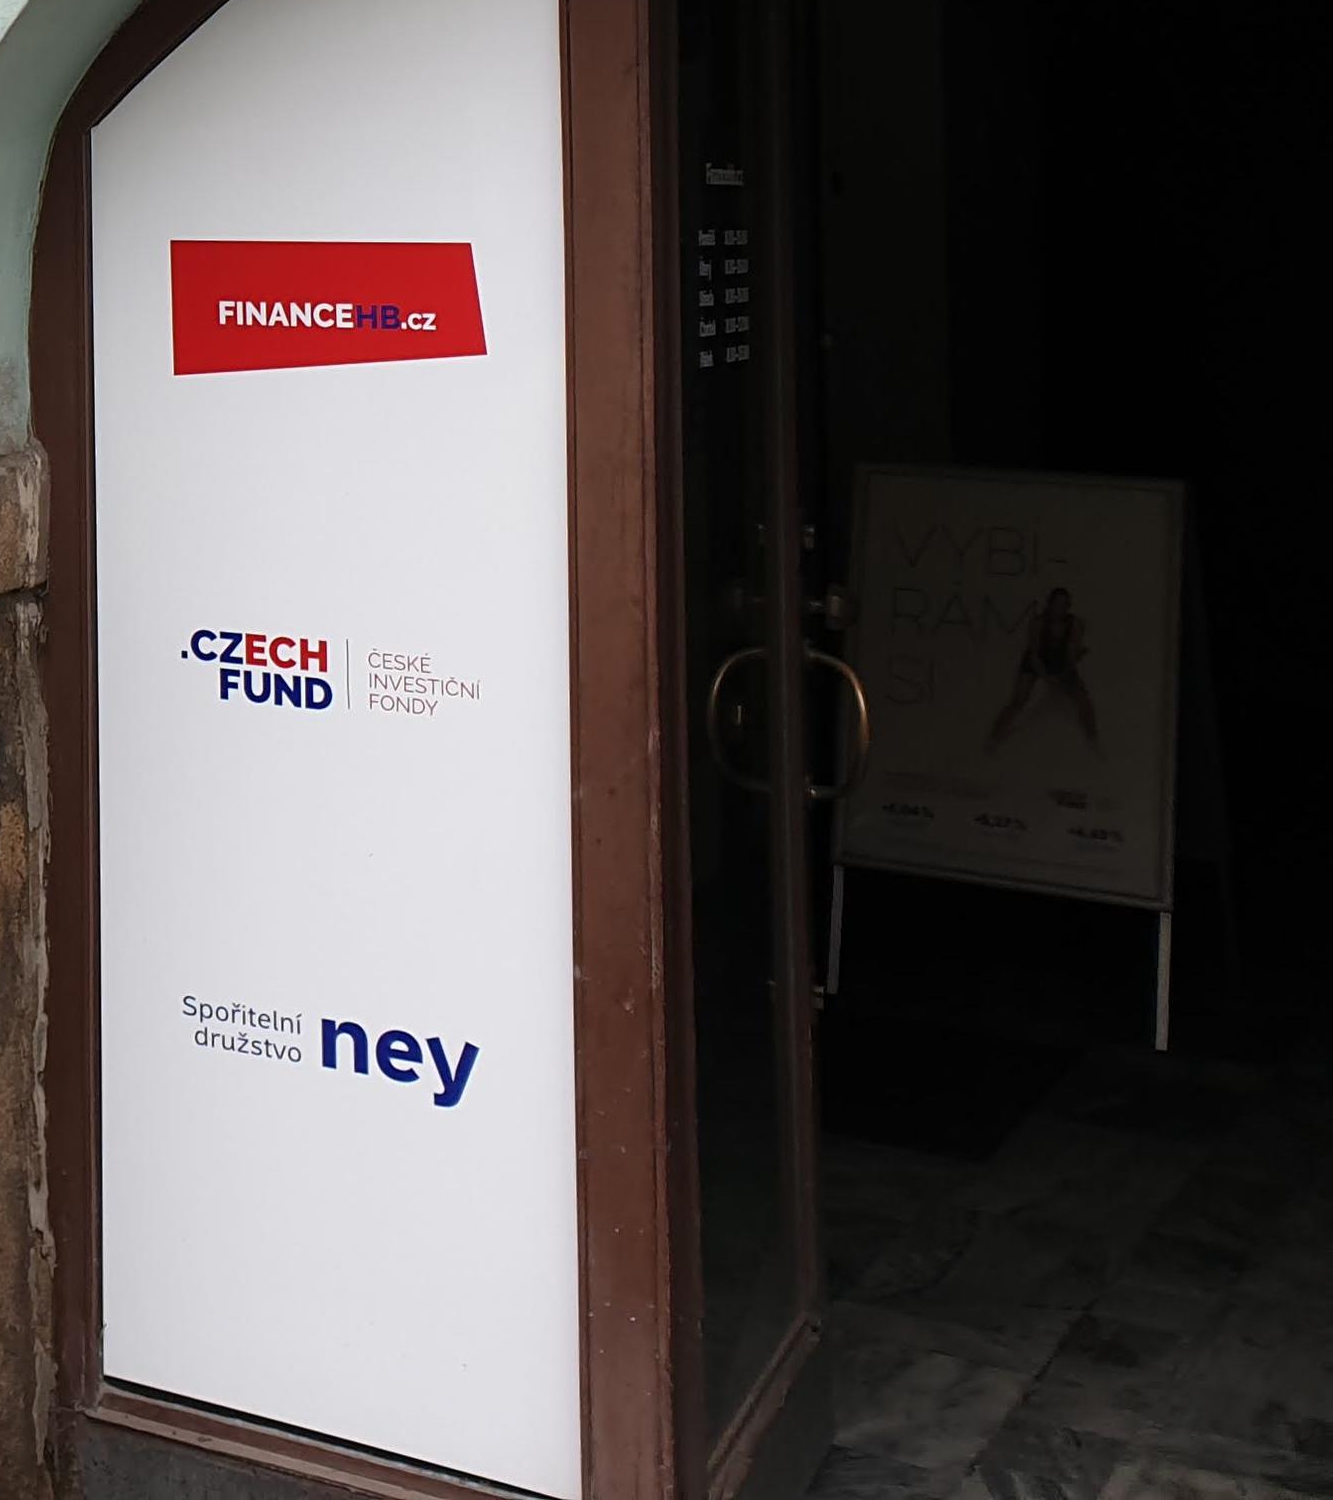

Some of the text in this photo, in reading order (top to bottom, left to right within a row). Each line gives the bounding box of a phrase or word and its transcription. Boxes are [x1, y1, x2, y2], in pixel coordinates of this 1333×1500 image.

[218, 300, 437, 331] FINANCEHB.cz
[368, 649, 432, 674] ČESKÉ
[219, 668, 333, 710] FUND
[369, 673, 481, 700] INVESTIČNÍ
[369, 693, 439, 716] FONDY
[182, 995, 303, 1035] Spořitelní
[194, 1026, 302, 1063] družstvo
[321, 1017, 480, 1108] ney
